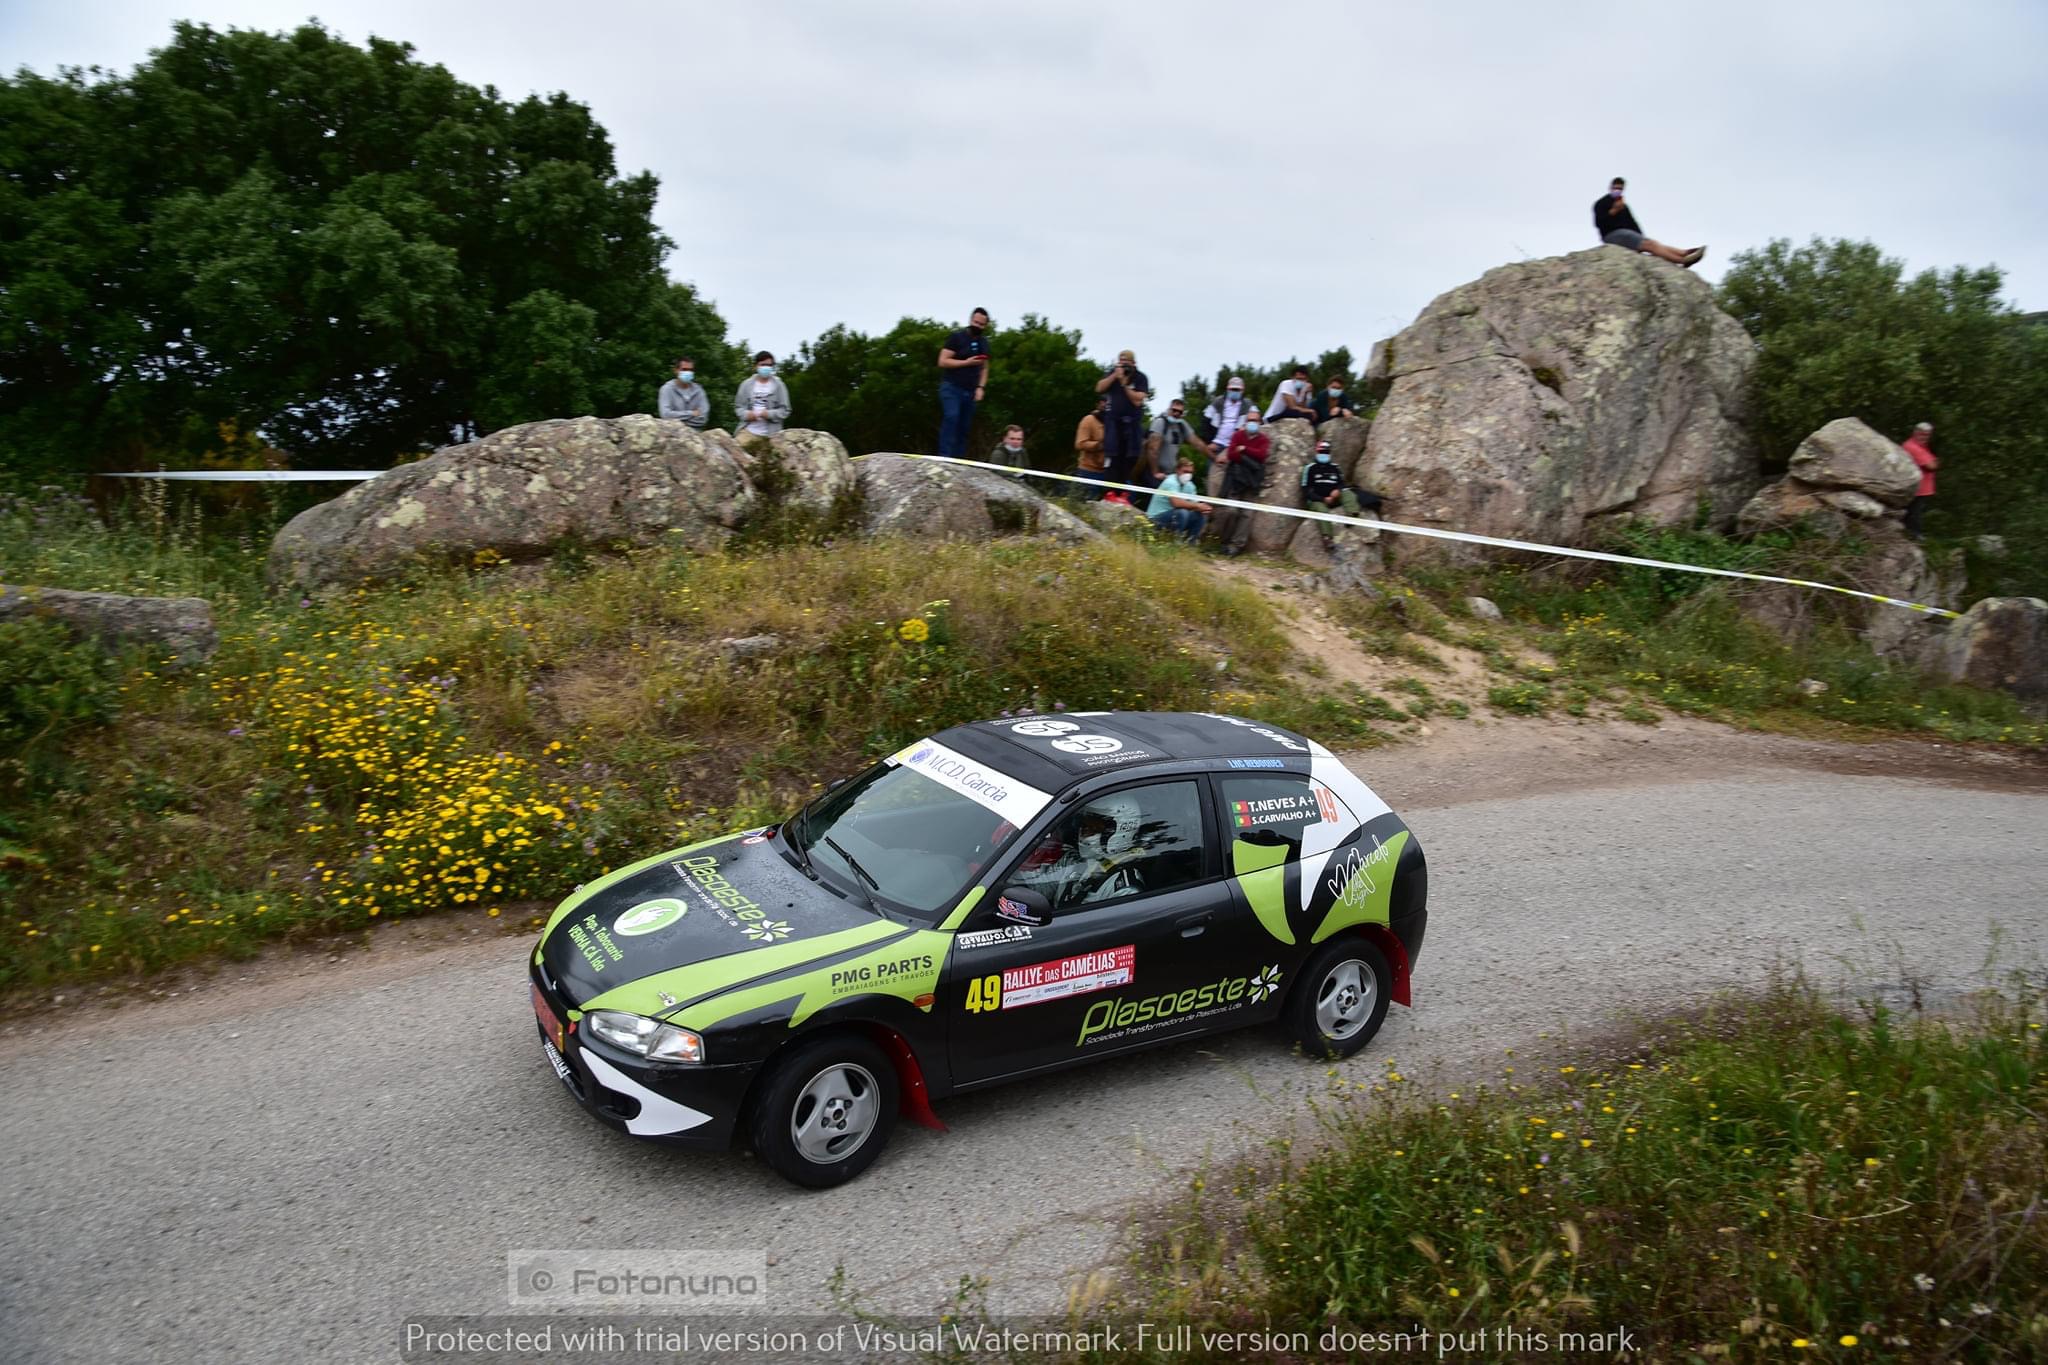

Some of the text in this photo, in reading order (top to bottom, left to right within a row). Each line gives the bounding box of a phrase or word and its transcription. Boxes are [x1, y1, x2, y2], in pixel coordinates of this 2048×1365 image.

[962, 771, 1008, 803] Garcia
[1248, 795, 1315, 813] T.NEVES A+
[1252, 810, 1318, 826] S.CARVALHO A+
[1315, 788, 1340, 824] 49
[671, 855, 767, 921] Plasoeste
[832, 955, 933, 987] PMG PARTS
[1003, 966, 1043, 991] RALLYE
[1044, 968, 1060, 983] DAS
[1061, 952, 1117, 979] CAMÉLIAS
[965, 974, 1001, 1014] 49
[1076, 977, 1248, 1048] Plasoeste
